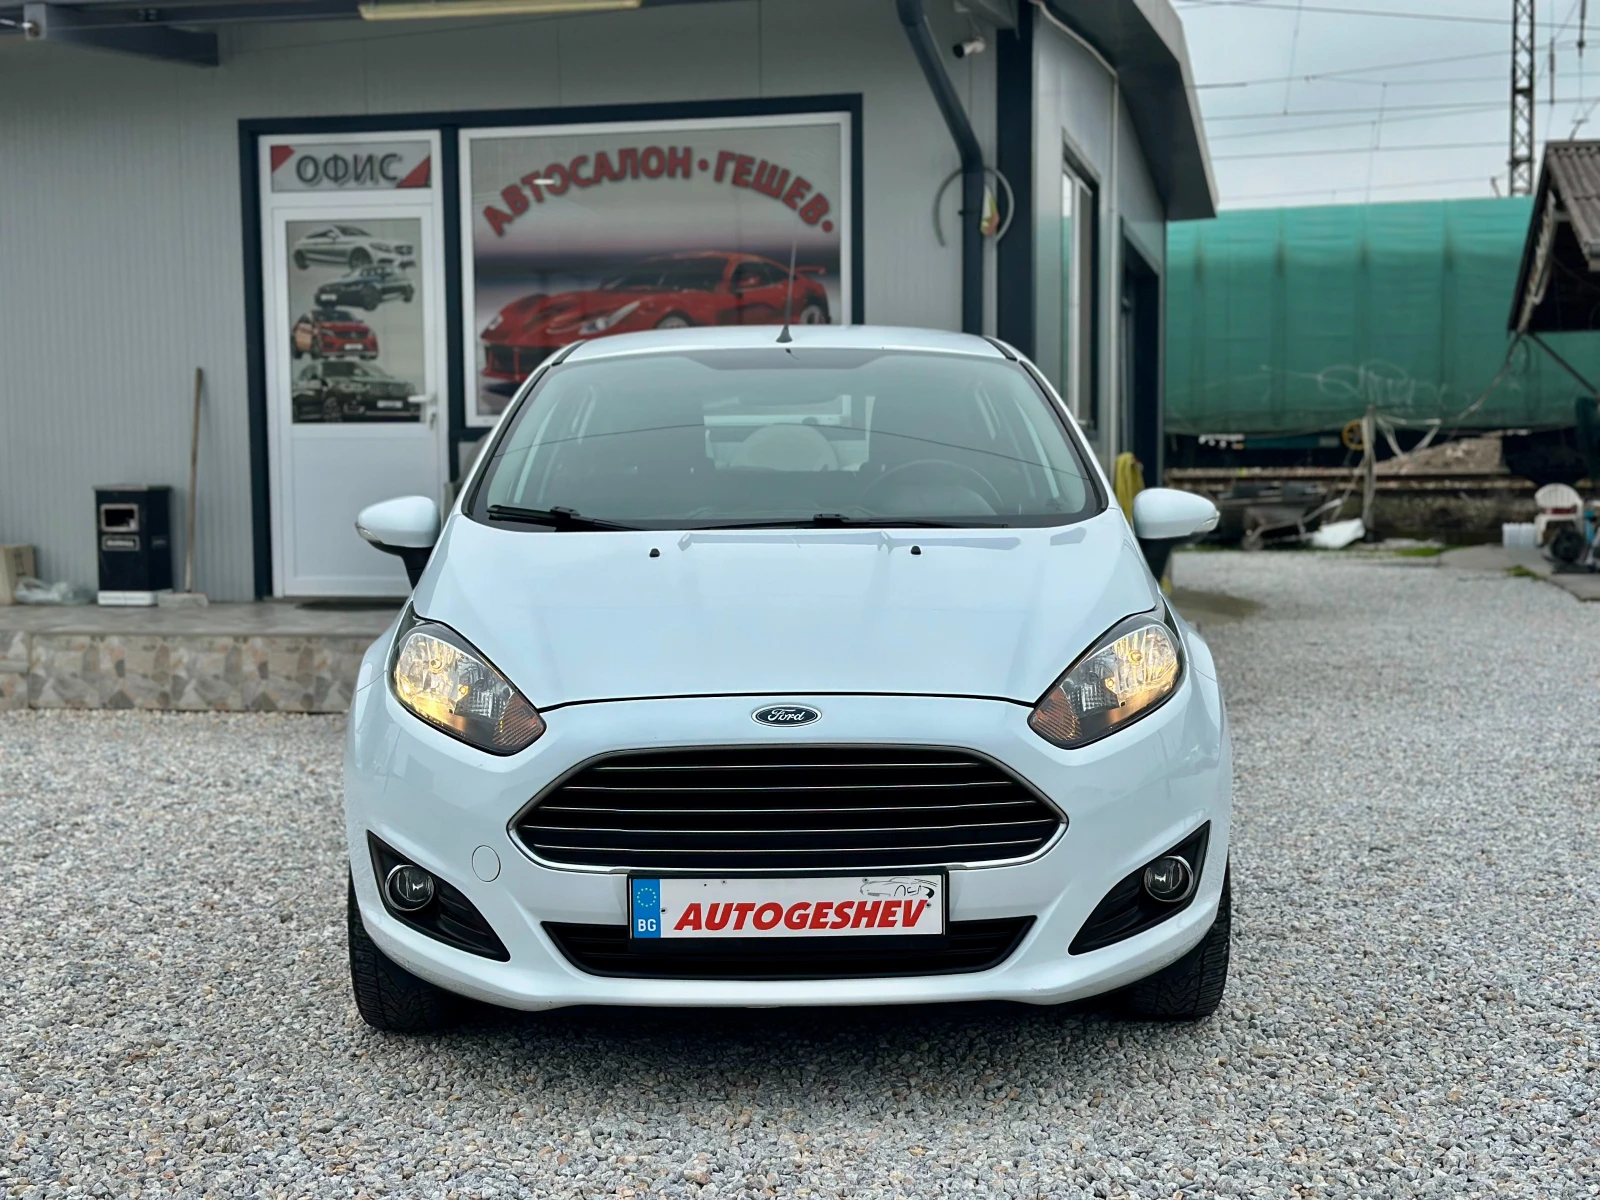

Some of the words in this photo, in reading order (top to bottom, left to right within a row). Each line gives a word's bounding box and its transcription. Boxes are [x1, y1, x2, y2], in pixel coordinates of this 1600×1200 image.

[296, 153, 403, 184] ОФИС
[483, 146, 693, 237] АВТОСАЛОН
[767, 708, 806, 721] Ford
[637, 918, 657, 932] BG
[673, 899, 928, 931] AUTOGESHEV
